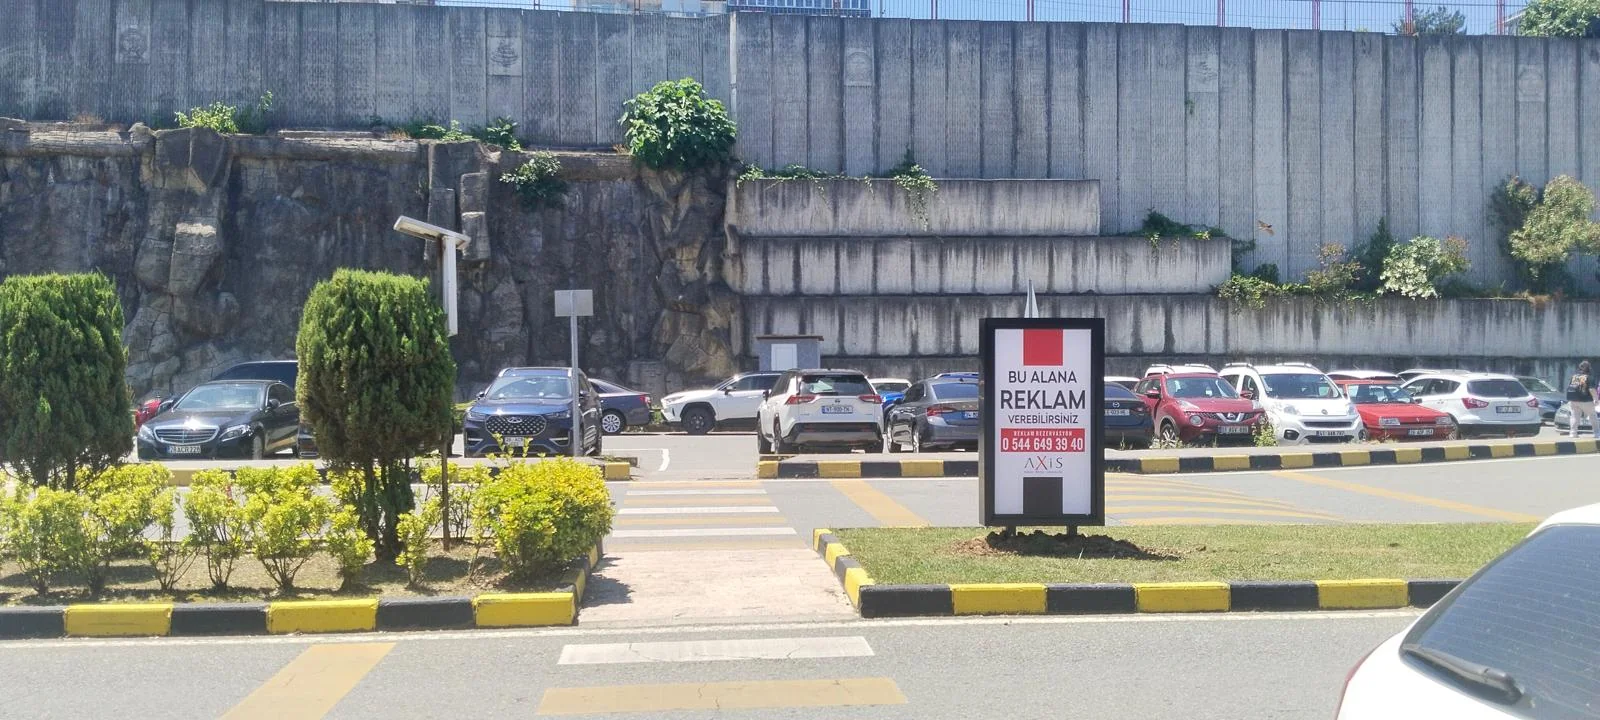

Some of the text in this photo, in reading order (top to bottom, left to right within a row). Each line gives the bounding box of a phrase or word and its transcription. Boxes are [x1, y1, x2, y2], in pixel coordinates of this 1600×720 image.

[1008, 371, 1077, 383] BU ALANA
[1000, 390, 1086, 409] REKLAM
[1008, 413, 1078, 424] VEREBİLİRSİNİZ
[1002, 438, 1083, 450] 0 544 649 39 40
